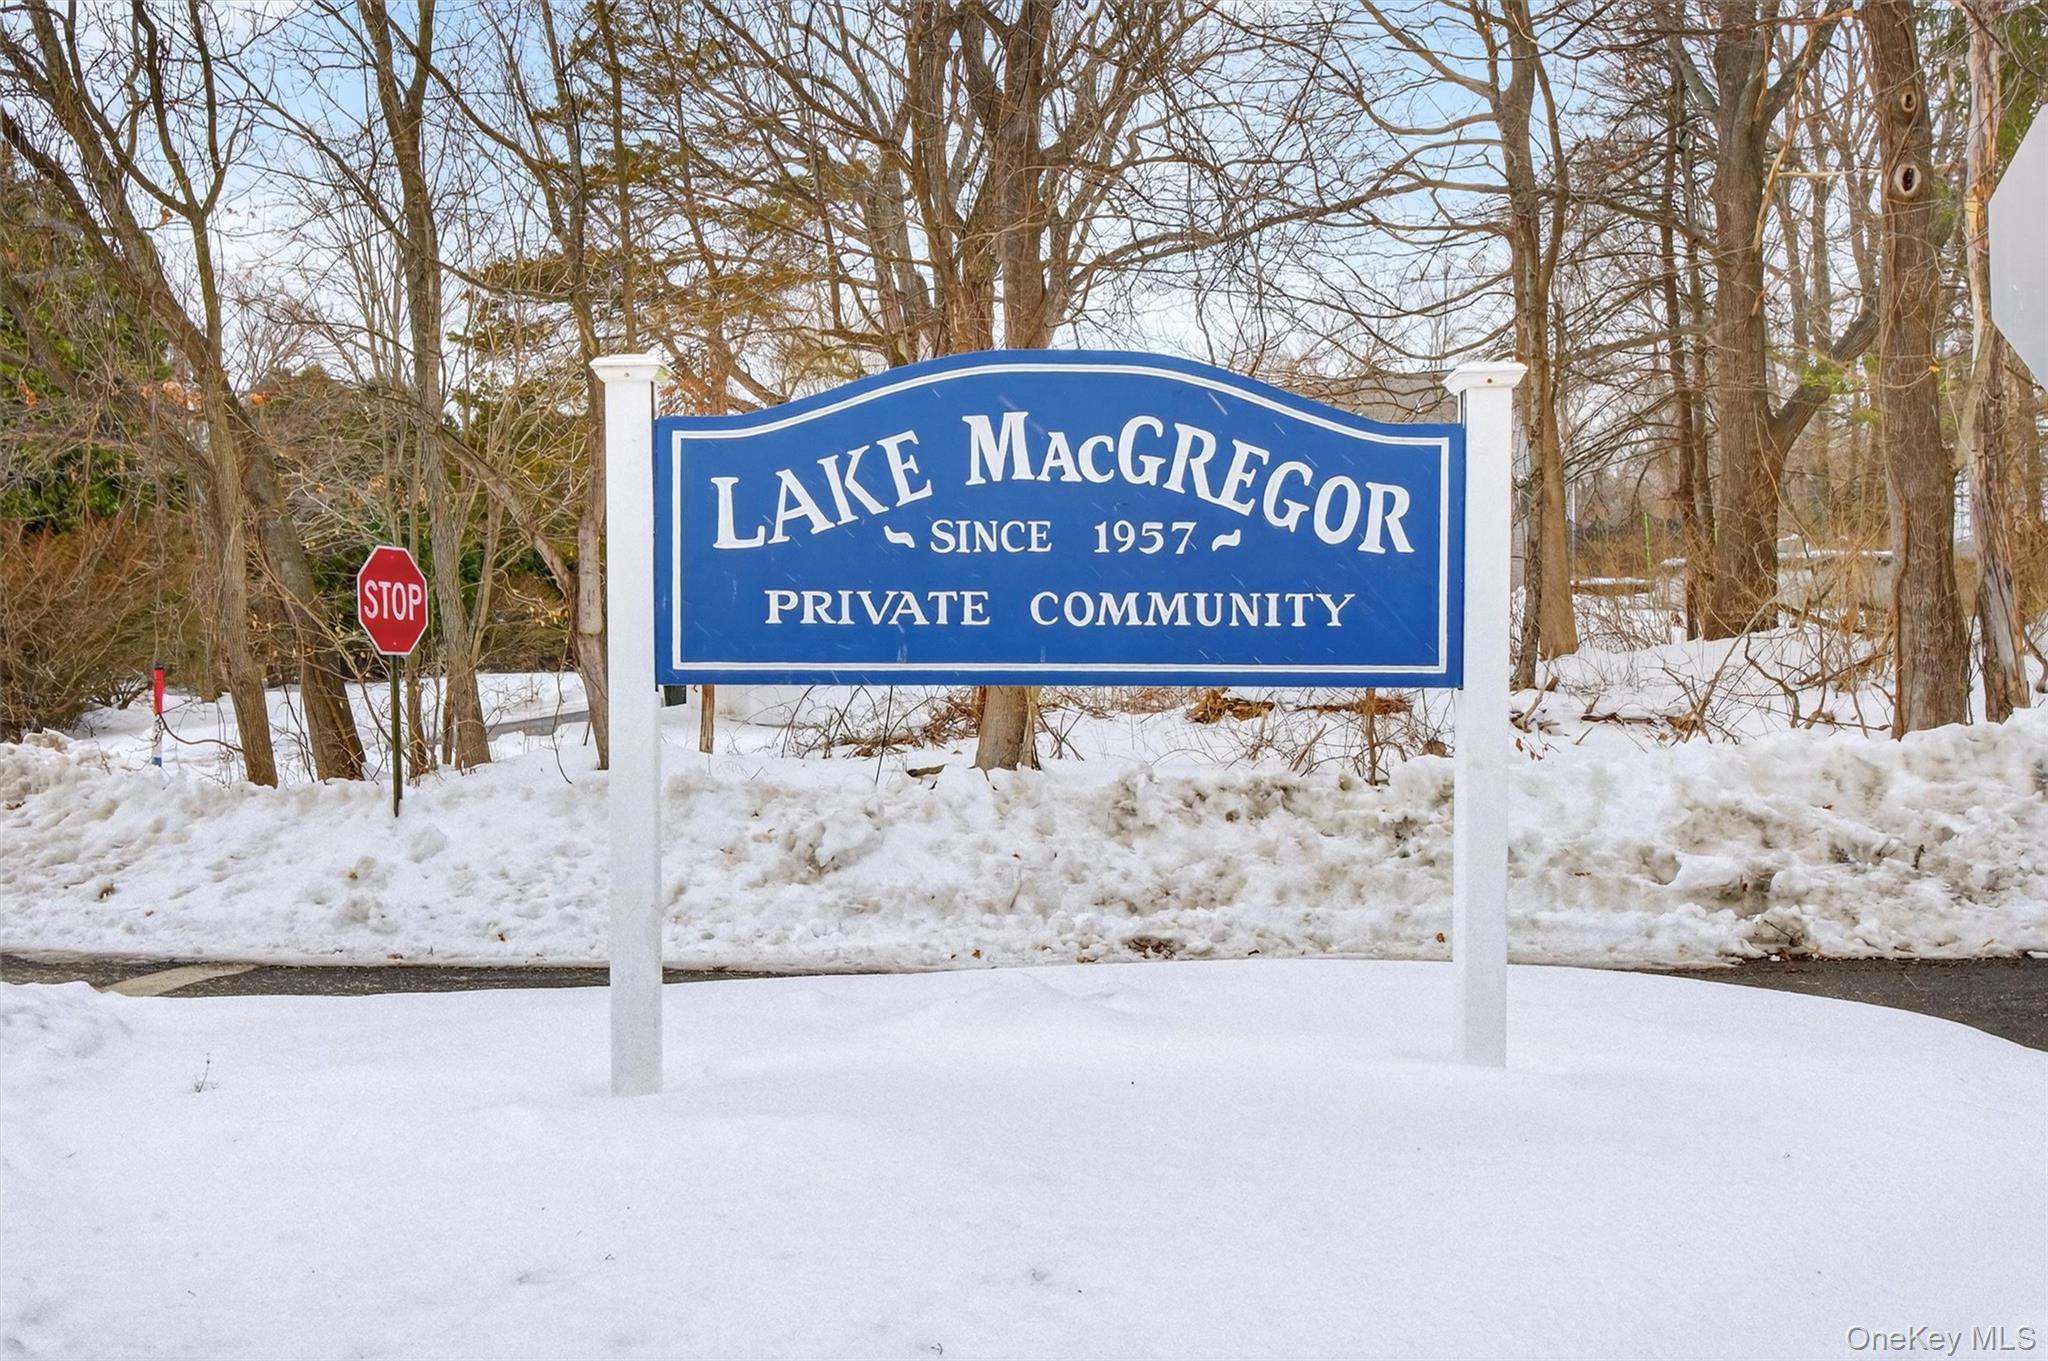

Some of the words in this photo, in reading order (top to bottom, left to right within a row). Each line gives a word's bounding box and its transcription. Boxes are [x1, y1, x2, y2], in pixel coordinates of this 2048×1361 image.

[710, 430, 933, 549] LAKE
[930, 519, 1052, 554] SINCE
[1094, 519, 1197, 555] 1957
[363, 580, 422, 621] STOP
[764, 590, 990, 626] PRIVATE
[1030, 591, 1355, 627] COMMUNITY
